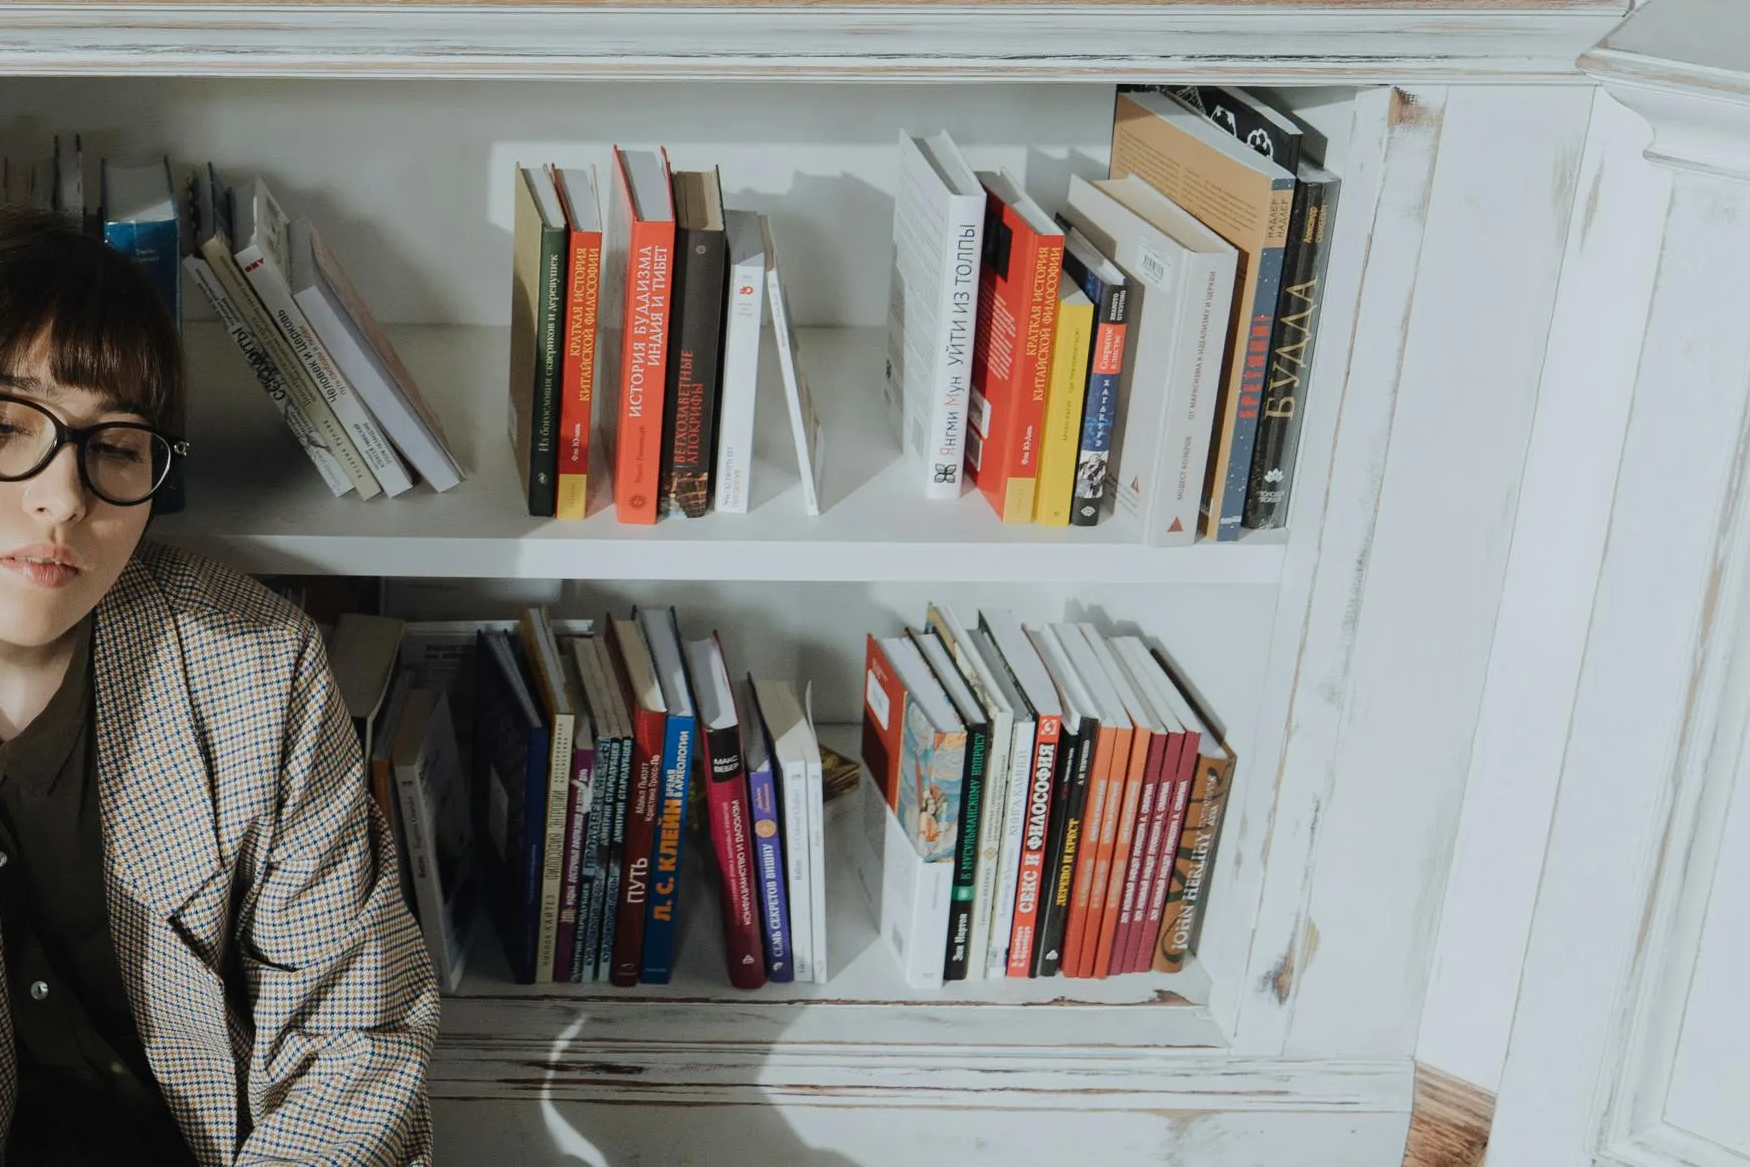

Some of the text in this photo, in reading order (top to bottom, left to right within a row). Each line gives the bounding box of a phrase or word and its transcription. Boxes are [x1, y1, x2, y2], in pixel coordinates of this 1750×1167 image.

[628, 245, 652, 417] ИСТОРИЯ БУДДИЗМА
[649, 245, 668, 366] ИНДИЯ И ТИБЕТ
[944, 223, 976, 366] УЙТИ ИЗ ТОЛПЫ
[1264, 277, 1318, 419] БУДДА
[627, 858, 648, 904] ПУТЬ
[654, 800, 682, 921] Л. С. КЛЕЙН
[1019, 744, 1055, 913] СЕКС И ФИЛОСОФИЯ
[1171, 830, 1212, 951] JOHN HERLIHY
